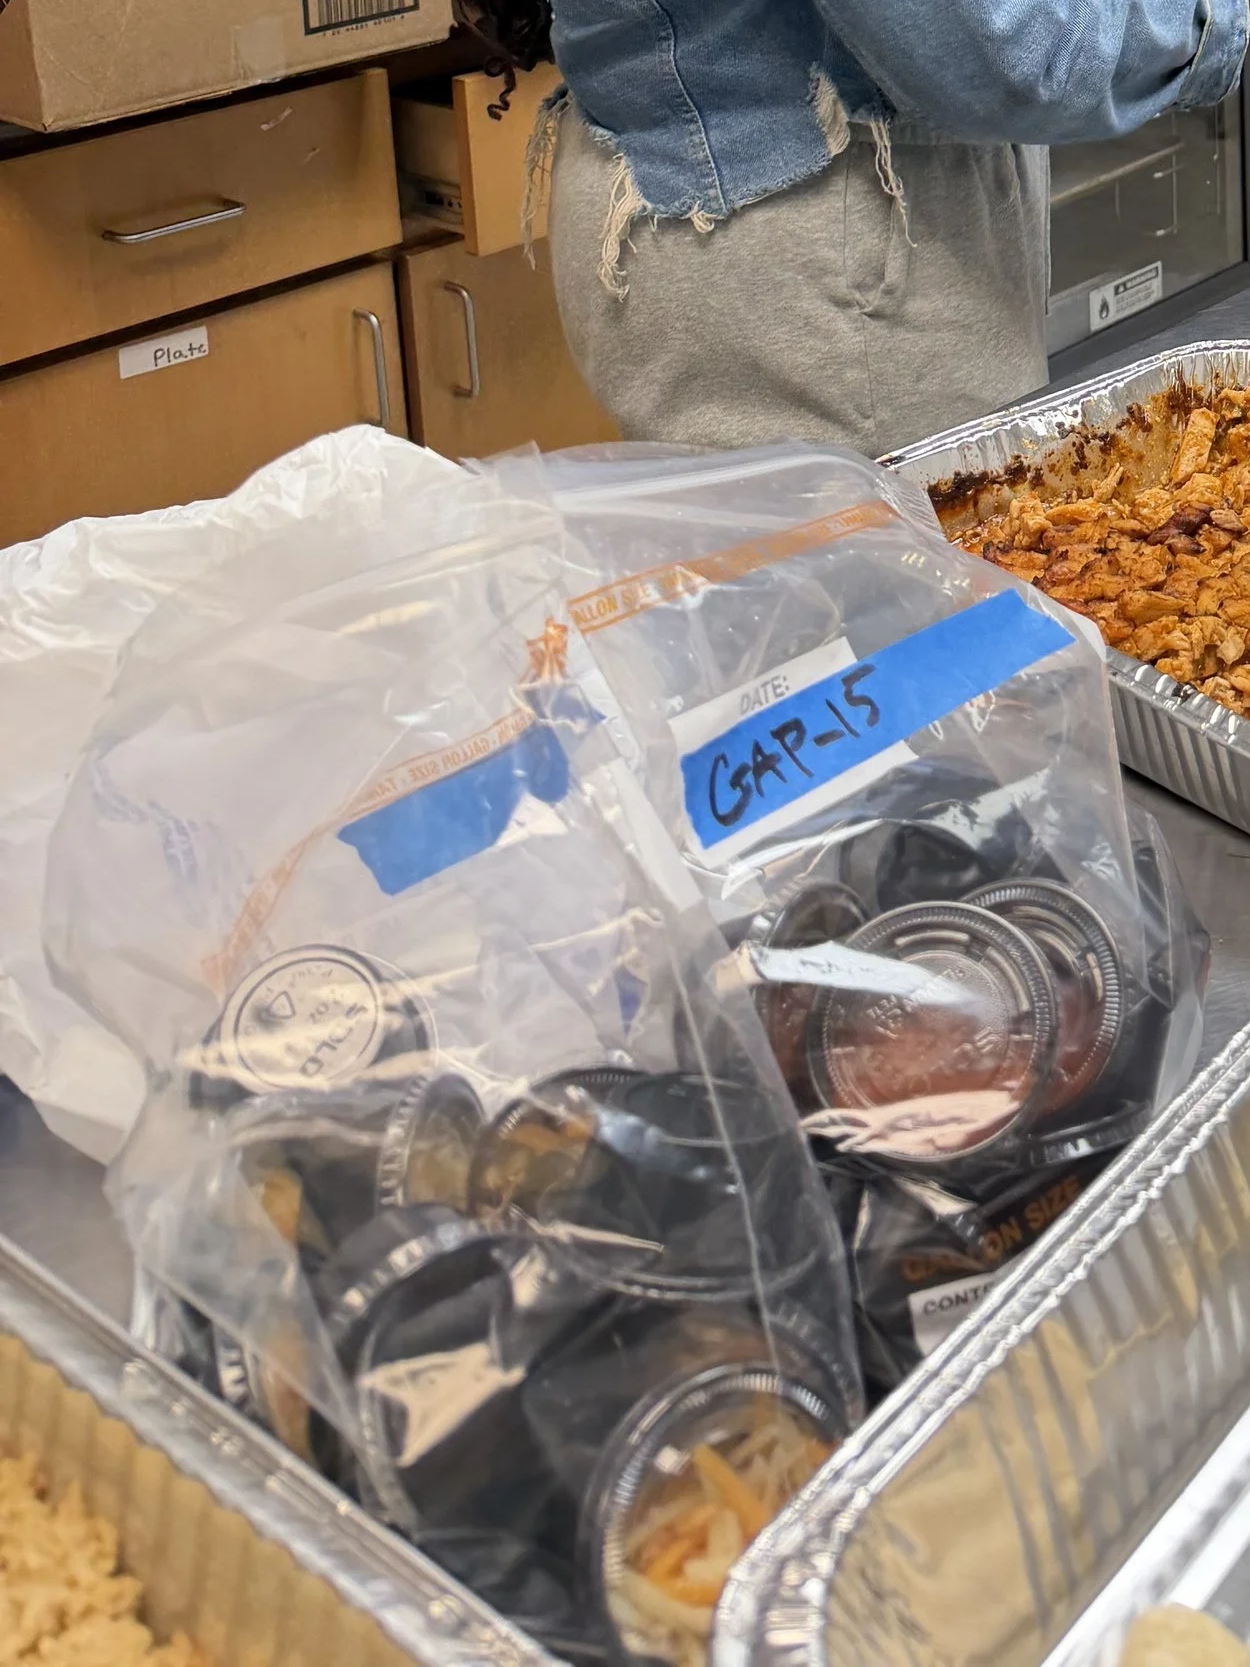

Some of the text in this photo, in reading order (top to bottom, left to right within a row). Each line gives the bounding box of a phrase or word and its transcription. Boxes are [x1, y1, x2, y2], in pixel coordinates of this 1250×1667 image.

[153, 342, 207, 368] Plate
[739, 674, 791, 716] DATE:
[708, 662, 882, 827] GAP-15
